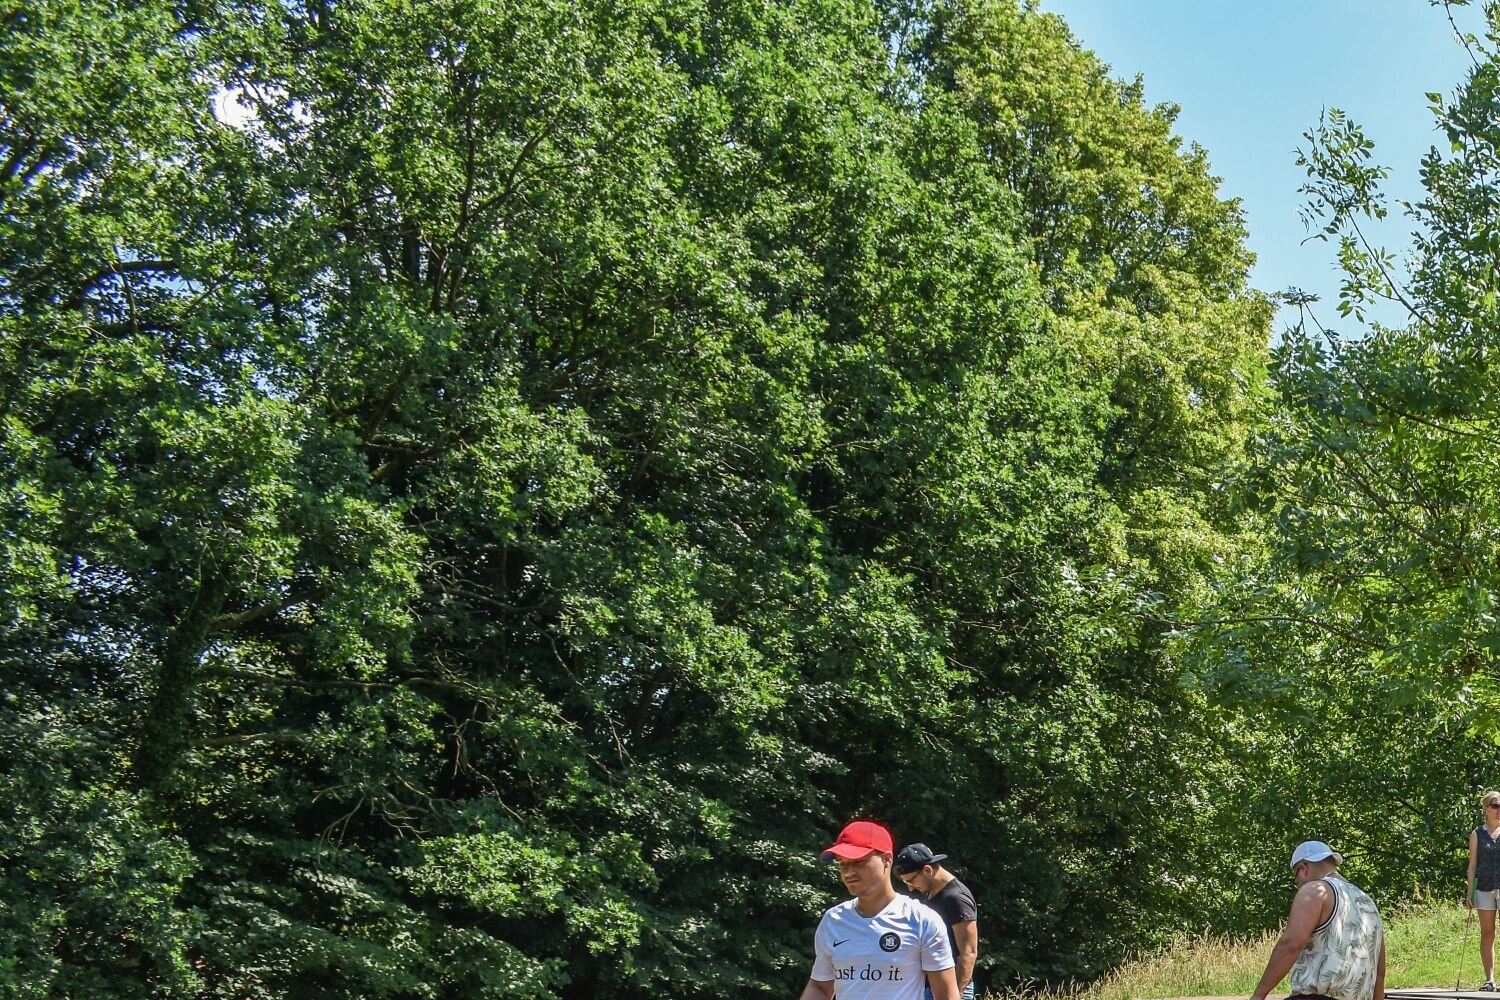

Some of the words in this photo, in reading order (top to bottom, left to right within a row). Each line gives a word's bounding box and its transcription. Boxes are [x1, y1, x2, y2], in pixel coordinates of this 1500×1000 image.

[832, 964, 856, 981] ust
[860, 963, 882, 981] do
[888, 965, 903, 981] it.
